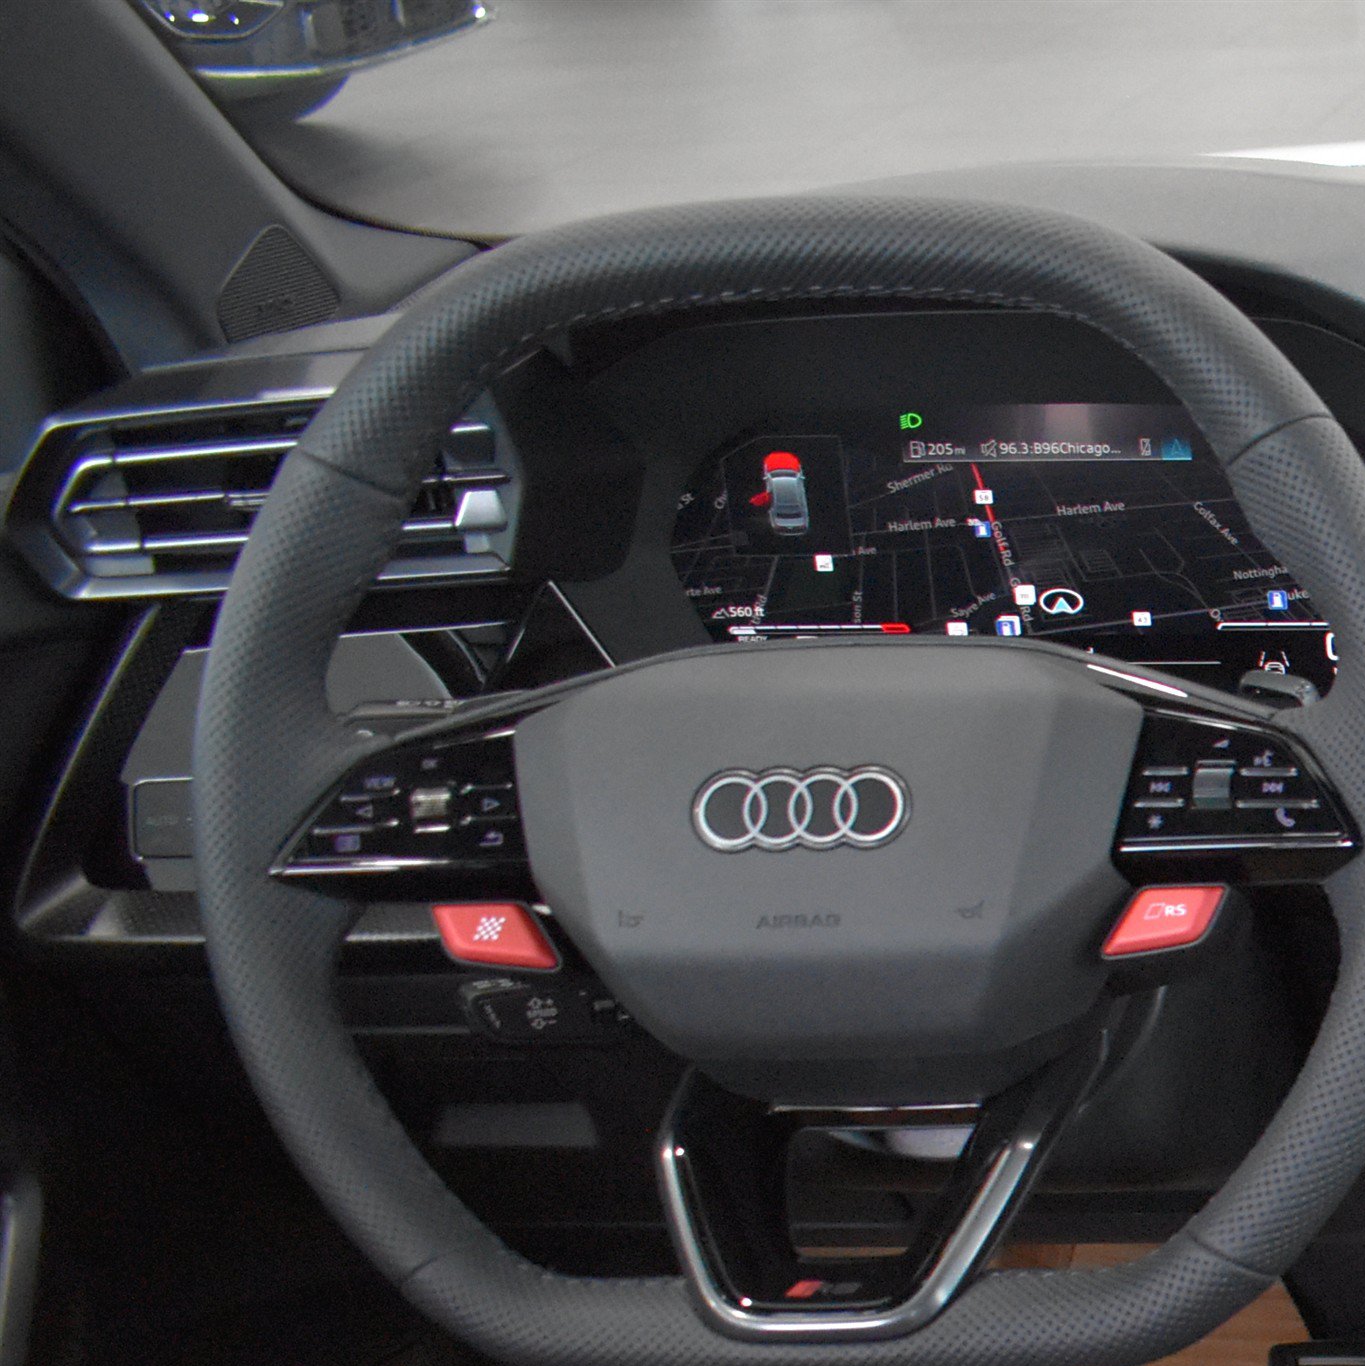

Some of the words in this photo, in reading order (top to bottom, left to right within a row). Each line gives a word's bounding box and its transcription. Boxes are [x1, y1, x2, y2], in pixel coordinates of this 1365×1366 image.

[928, 443, 953, 456] 205
[886, 468, 935, 494] Shermer
[1057, 504, 1101, 516] Harlem
[1104, 501, 1126, 512] Ave
[888, 520, 933, 532] Harlem
[936, 518, 956, 528] Ave
[1193, 501, 1223, 530] Colfax
[1220, 527, 1238, 546] Ave
[1000, 549, 1015, 567] Rd
[1233, 566, 1288, 581] Nottingha
[729, 607, 752, 618] 560
[951, 601, 979, 619] Sayre
[977, 592, 997, 608] Ave
[1021, 605, 1034, 623] Rd
[1164, 904, 1188, 916] RS
